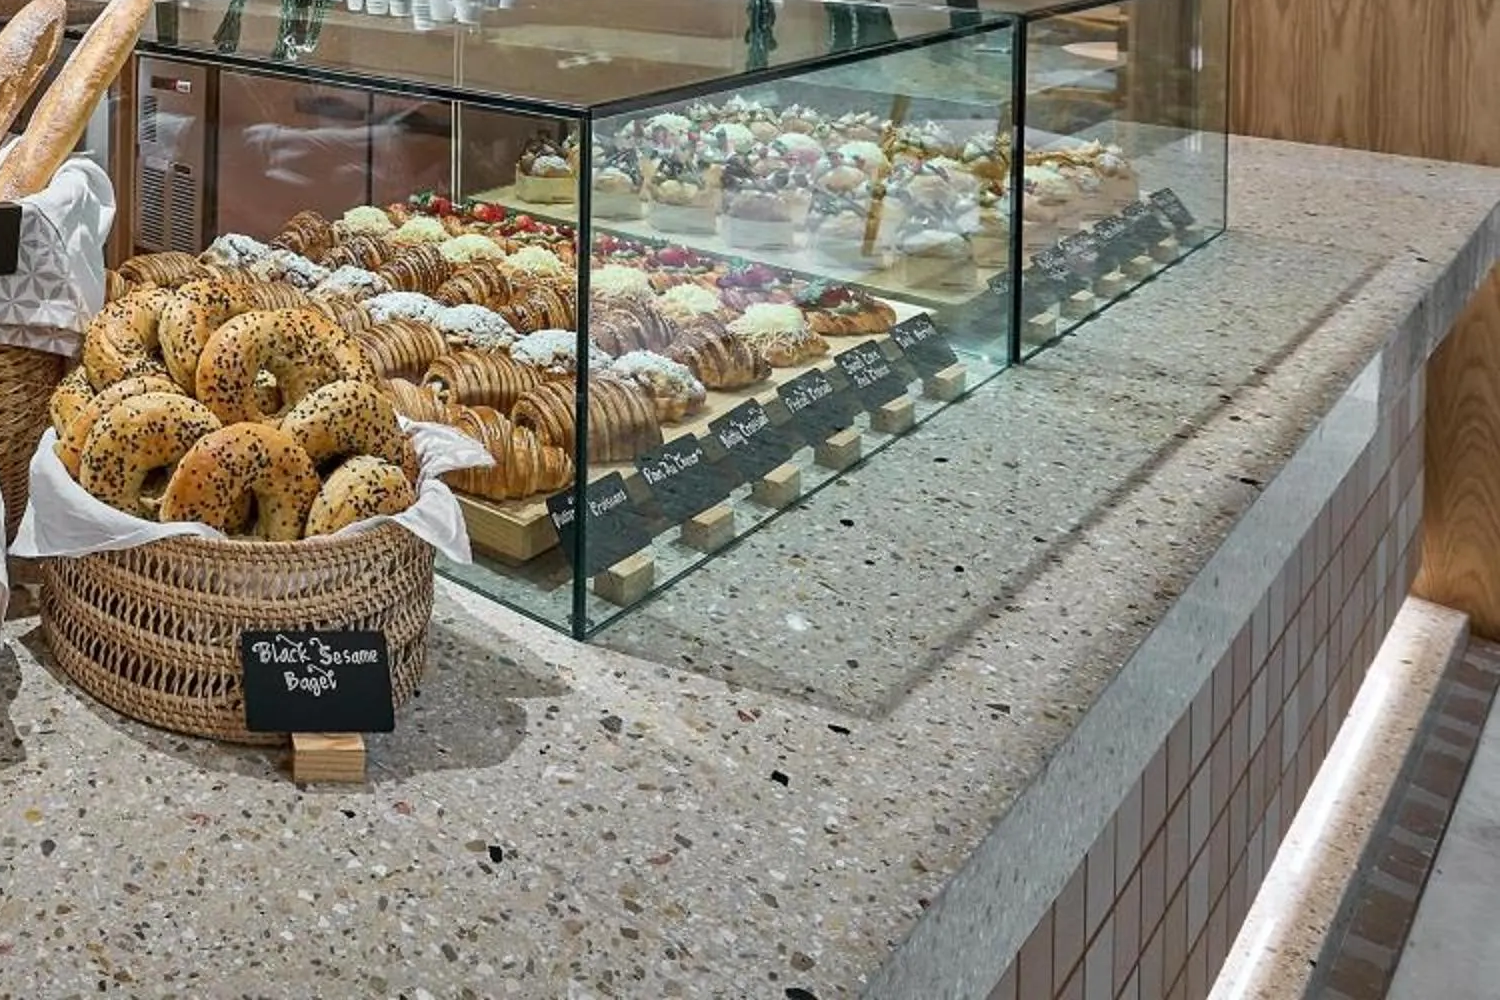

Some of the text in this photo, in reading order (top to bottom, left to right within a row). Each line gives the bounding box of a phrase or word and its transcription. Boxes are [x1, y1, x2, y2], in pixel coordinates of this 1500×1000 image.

[251, 633, 379, 665] Black Sesame
[283, 663, 338, 697] Bagel
